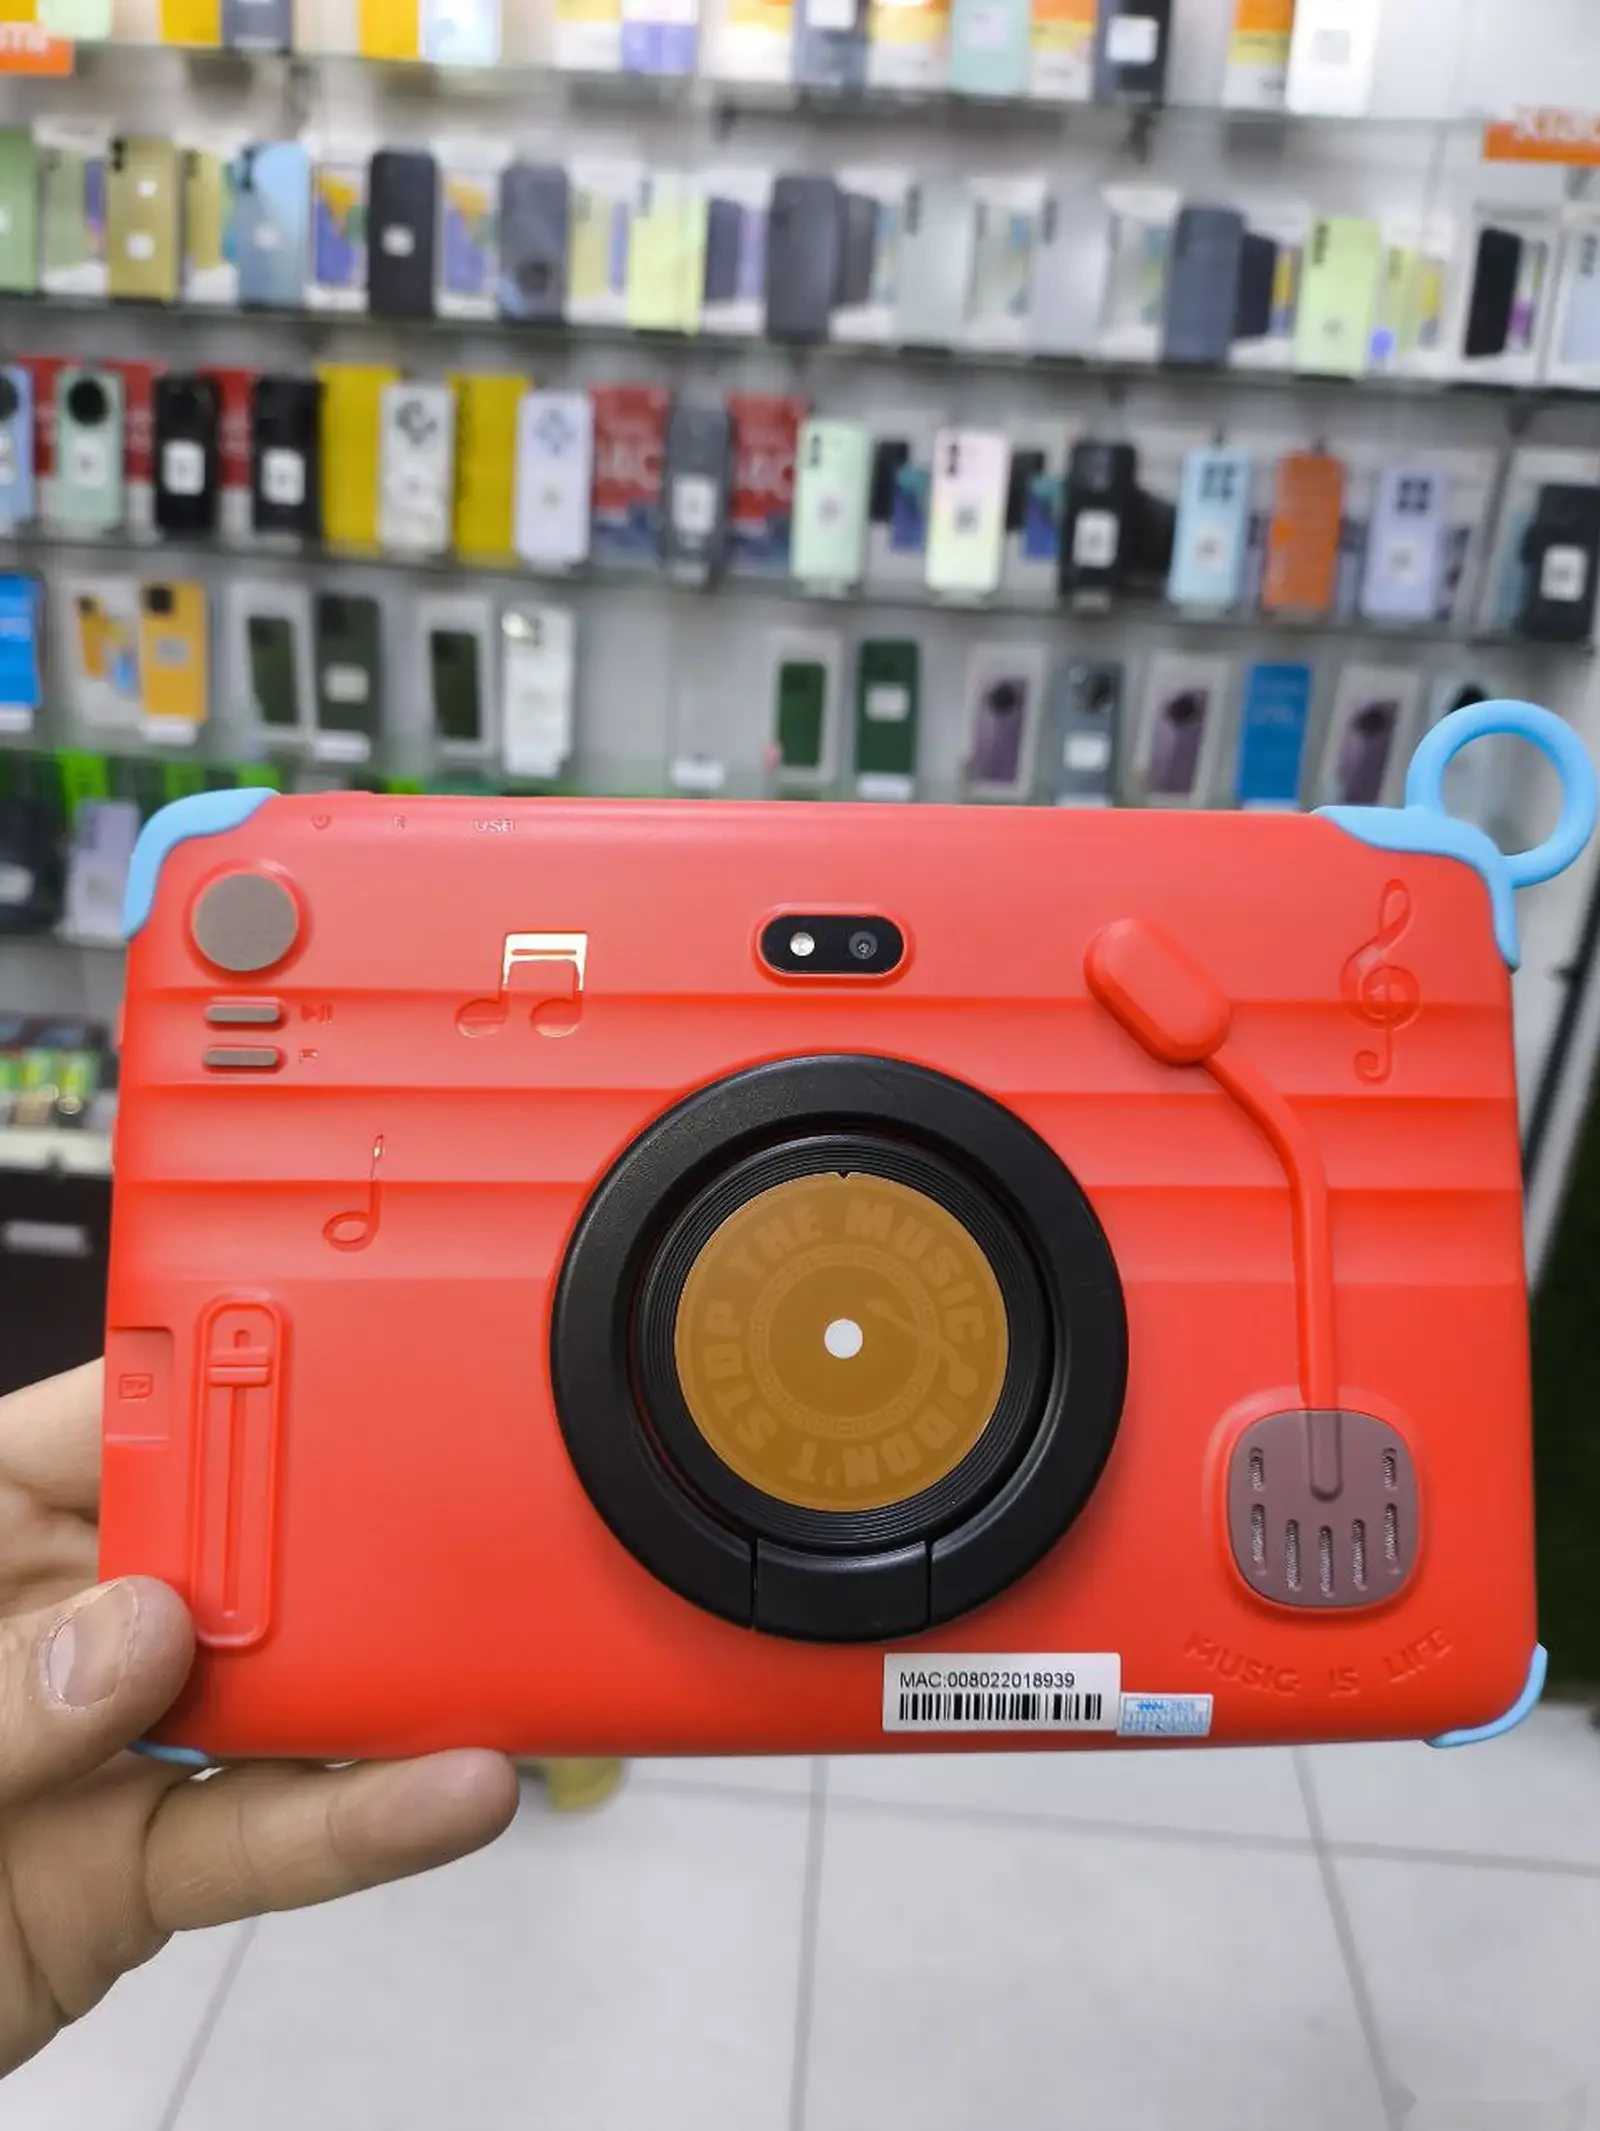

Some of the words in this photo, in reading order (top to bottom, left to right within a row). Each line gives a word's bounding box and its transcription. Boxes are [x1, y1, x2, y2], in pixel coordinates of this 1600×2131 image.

[473, 818, 516, 833] USB
[725, 1201, 824, 1280] THE
[844, 1197, 987, 1344] MUSIC
[702, 1300, 780, 1452] STOP
[786, 1406, 958, 1489] DON'T
[899, 1671, 1075, 1689] MAC:008022018939
[1328, 1666, 1360, 1697] IS
[1381, 1626, 1453, 1682] LIFE
